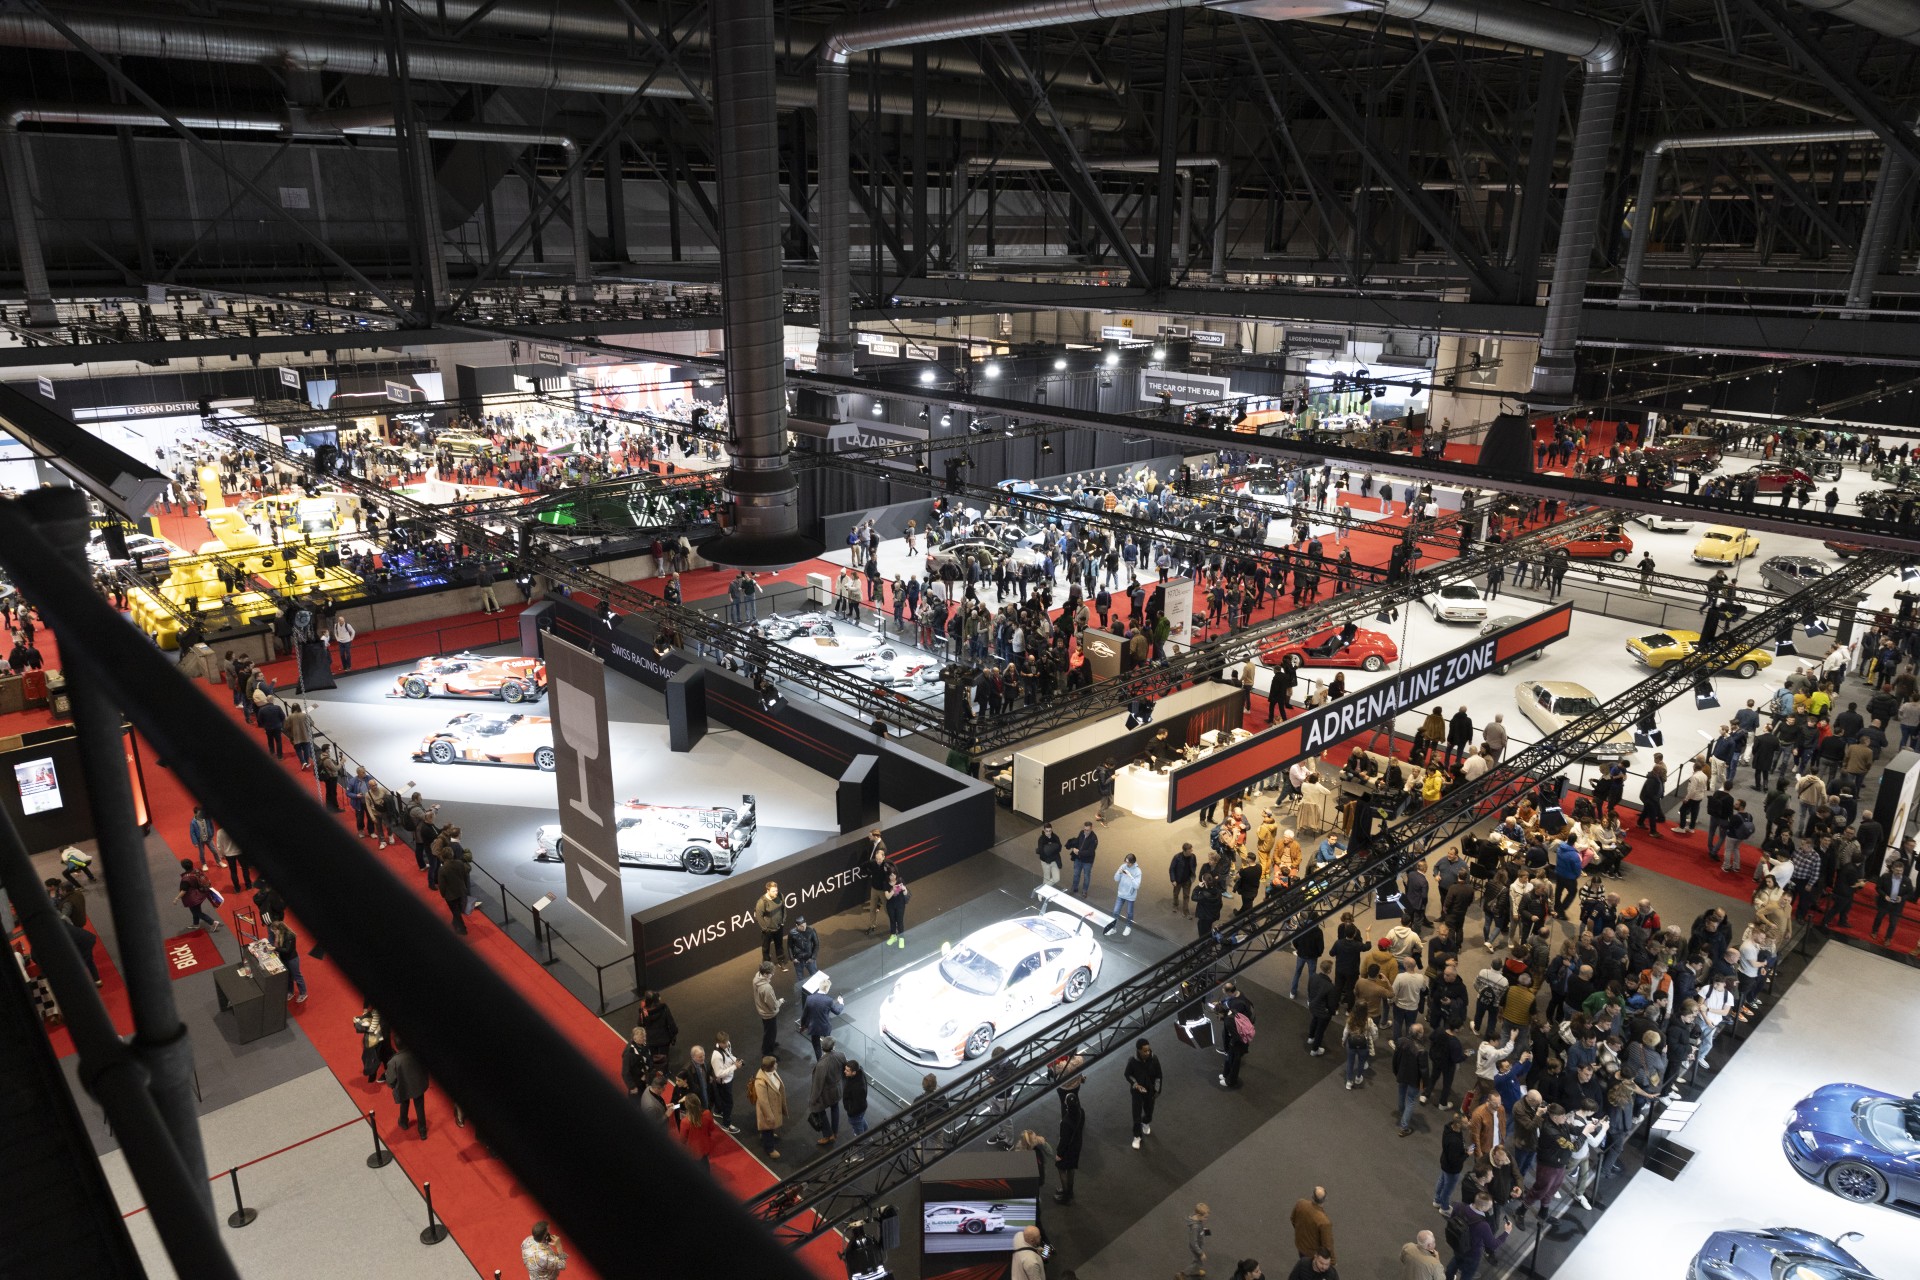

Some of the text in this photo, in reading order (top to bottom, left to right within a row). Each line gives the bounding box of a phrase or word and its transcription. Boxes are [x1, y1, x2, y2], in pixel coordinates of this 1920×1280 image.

[1123, 319, 1132, 327] 44
[1289, 335, 1340, 345] LEGENDS MAGAZINE
[394, 388, 403, 398] TCS
[1149, 382, 1220, 397] THE CAR OF THE YEAR
[127, 402, 200, 415] DESIGN DISTRIC
[611, 643, 631, 661] SWISS
[631, 652, 659, 674] RACING
[1305, 640, 1495, 752] ADRENALINE ZONE
[1061, 777, 1078, 796] PIT
[673, 920, 727, 955] SWISS
[731, 892, 797, 932] RAG
[169, 943, 198, 970] Blick
